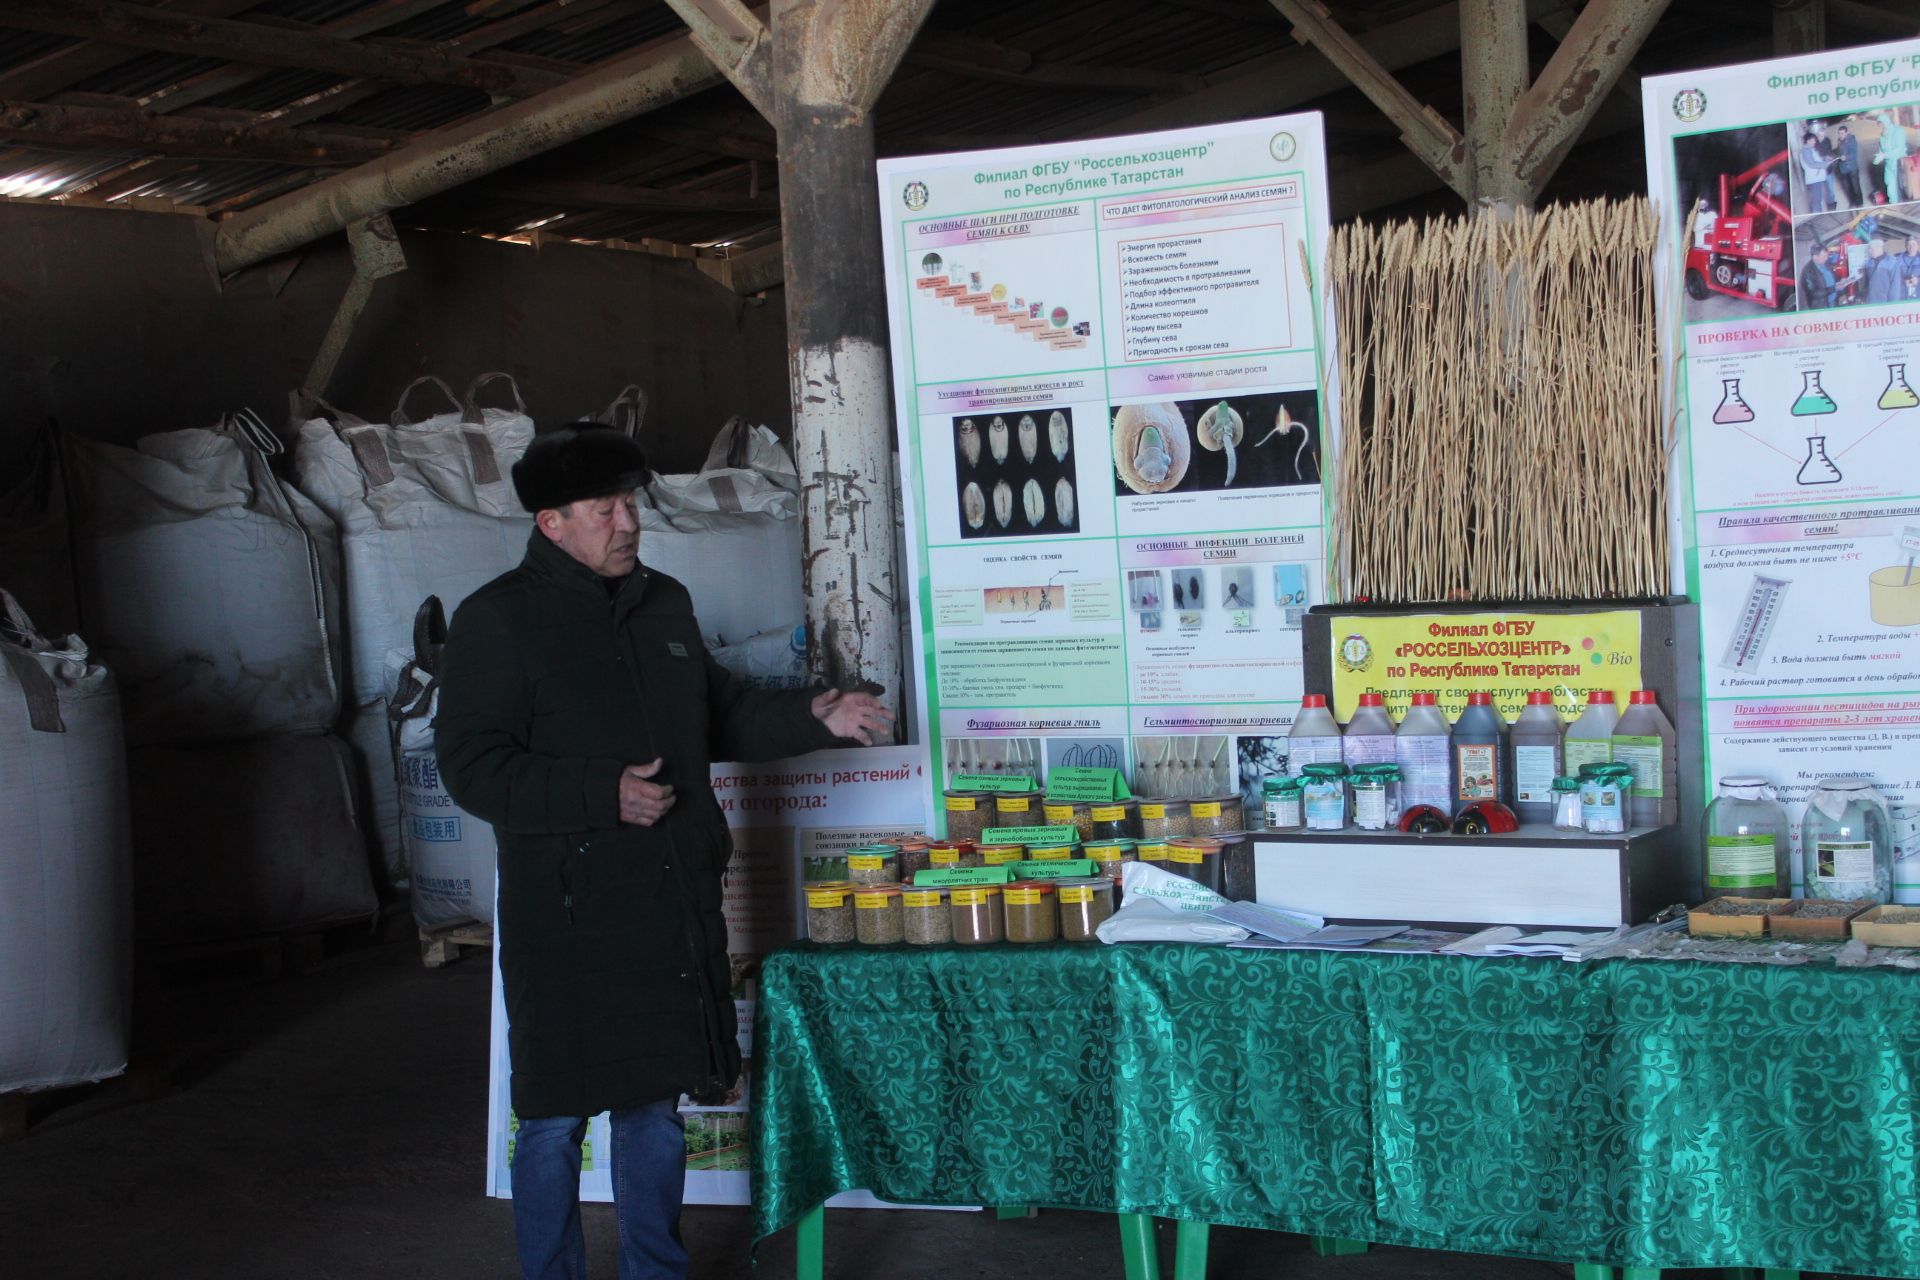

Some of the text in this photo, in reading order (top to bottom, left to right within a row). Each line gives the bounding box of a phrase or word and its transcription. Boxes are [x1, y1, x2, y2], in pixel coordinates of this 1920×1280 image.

[1768, 58, 1896, 88] Филиал ФГБУ
[1808, 92, 1830, 104] по
[974, 141, 1214, 184] Филиал ФГБУ "Россельхозцентр"
[1004, 166, 1184, 199] по Республике Татарстан
[1106, 188, 1288, 216] ЧТО ДАЕТ ФИТОПАТОЛОГИЧЕСКИЙ АНАЛИЗ СЕМЯН
[918, 206, 1080, 233] ОСНОВНЫЕ ШАГИ ПРИ ПОДГОТОВКЕ
[966, 224, 1030, 240] СЕМЯН К СЕВУ
[1128, 238, 1202, 252] Энергия прорастания
[1128, 251, 1187, 264] Всхожесть семян
[1128, 260, 1219, 275] Зараженность болезнями
[1129, 275, 1184, 287] Необходимость
[1192, 268, 1251, 282] протравливании
[1130, 279, 1259, 299] Подбор эффективного протравителя
[1130, 298, 1196, 311] Длина колеоптиля
[1131, 308, 1208, 322] Количество корешков
[1132, 322, 1182, 334] Норму высева
[1133, 334, 1160, 345] Глубину
[1698, 329, 1768, 345] ПРОВЕРКА
[1771, 328, 1790, 338] НА
[1133, 346, 1178, 358] Пригодность
[1186, 344, 1211, 354] срокам
[1213, 341, 1229, 349] сева
[1148, 365, 1267, 382] Самые уязвимые стадии роста
[1718, 516, 1760, 526] Правила
[1763, 512, 1837, 524] качественного
[1804, 524, 1839, 534] семян!
[1136, 534, 1304, 550] ОСНОВНЫЕ ИНФЕКЦИИ БОЛЕЗНЕЙ
[1204, 550, 1236, 558] СЕМЯН
[1719, 546, 1791, 558] Среднесуточная
[1793, 542, 1854, 554] температура
[1010, 554, 1038, 562] СВОЙСТВ
[1704, 559, 1735, 569] воздуха
[1736, 558, 1771, 568] должна
[1773, 556, 1797, 565] быть
[1812, 555, 1837, 563] ниже
[1428, 621, 1535, 637] Филиал ФГБУ
[1827, 633, 1886, 643] Температура
[1889, 632, 1910, 640] воды
[1395, 640, 1571, 658] «РОССЕЛЬХОЗЦЕНТР»
[1607, 652, 1632, 666] Bio
[1771, 651, 1902, 664] 3. Вода должна быть мягкой
[1387, 662, 1580, 681] по Республике Татарстан
[1720, 679, 1727, 687] 4.
[1730, 677, 1765, 687] Рабочий
[1767, 677, 1803, 687] раствор
[1806, 676, 1855, 684] готовится
[1865, 673, 1885, 682] день
[1735, 703, 1756, 713] При
[1758, 703, 1820, 714] удорожании
[1823, 701, 1884, 712] пестицидов
[967, 718, 1100, 729] Фузариозная корневая гниль
[1144, 716, 1292, 726] Гельминтоспориозная корневая
[1734, 715, 1884, 727] появятся препараты 2-3 лет
[1724, 733, 1894, 745] Содержание действующего вещества (Д. В.)
[1820, 745, 1852, 753] условий
[764, 772, 826, 788] защиты
[832, 764, 910, 787] растений
[1814, 772, 1875, 781] рекомендуем:
[423, 795, 450, 807] GRADE
[721, 794, 828, 815] и огорода:
[816, 830, 905, 841] Полезные насекомые
[816, 841, 857, 849] союзники
[1181, 902, 1212, 911] ЦЕНТР
